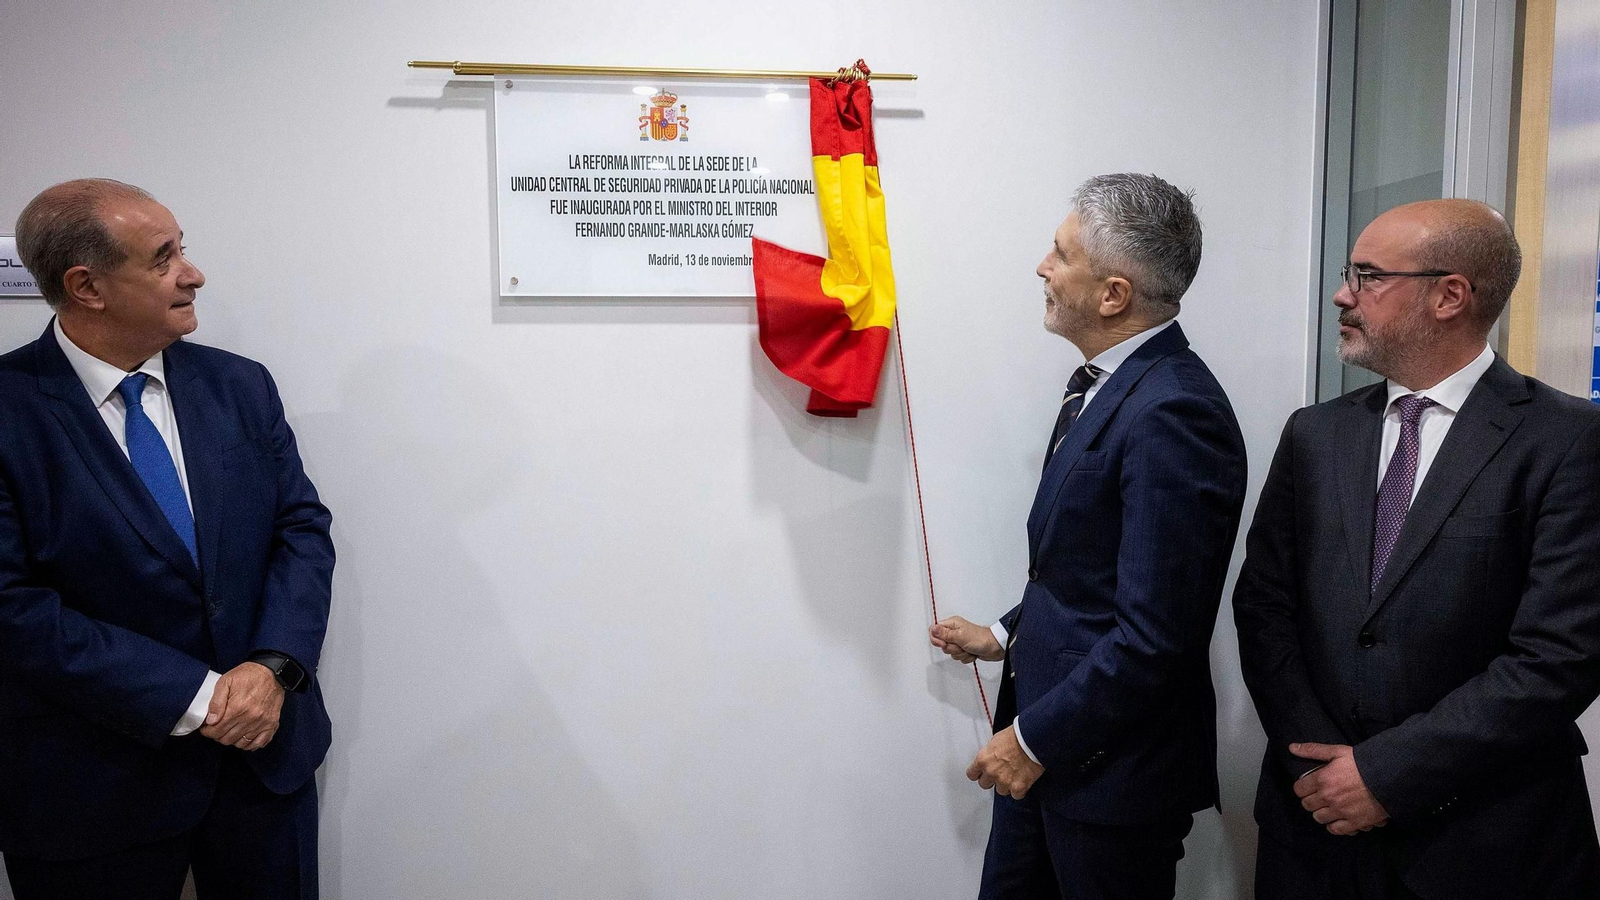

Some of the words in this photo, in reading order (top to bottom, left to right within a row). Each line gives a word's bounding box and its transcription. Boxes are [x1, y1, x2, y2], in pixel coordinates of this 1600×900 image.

[569, 155, 581, 169] LA
[582, 155, 629, 170] REFORMA
[679, 156, 690, 170] DE
[693, 156, 704, 171] LA
[706, 156, 730, 171] SEDE
[732, 157, 744, 171] DE
[747, 157, 758, 171] LA
[511, 177, 546, 191] UNIDAD
[549, 177, 591, 192] CENTRAL
[594, 178, 606, 192] DE
[608, 178, 661, 193] SEGURIDAD
[664, 178, 702, 193] PRIVADA
[704, 179, 716, 193] DE
[719, 179, 730, 193] LA
[732, 176, 768, 194] POLICÍA
[770, 179, 815, 195] NACIONAL
[550, 200, 568, 215] FUE
[571, 200, 631, 215] INAUGURADA
[633, 200, 652, 215] POR
[655, 201, 666, 215] EL
[668, 201, 713, 216] MINISTRO
[716, 201, 733, 215] DEL
[735, 201, 778, 216] INTERIOR
[575, 222, 625, 237] FERNANDO
[628, 223, 720, 238] GRANDE-MARLASKA
[722, 219, 754, 238] GÓMEZ
[648, 254, 682, 267] Madrid,
[685, 254, 696, 265] 13
[698, 254, 709, 266] de
[712, 254, 754, 266] noviembr
